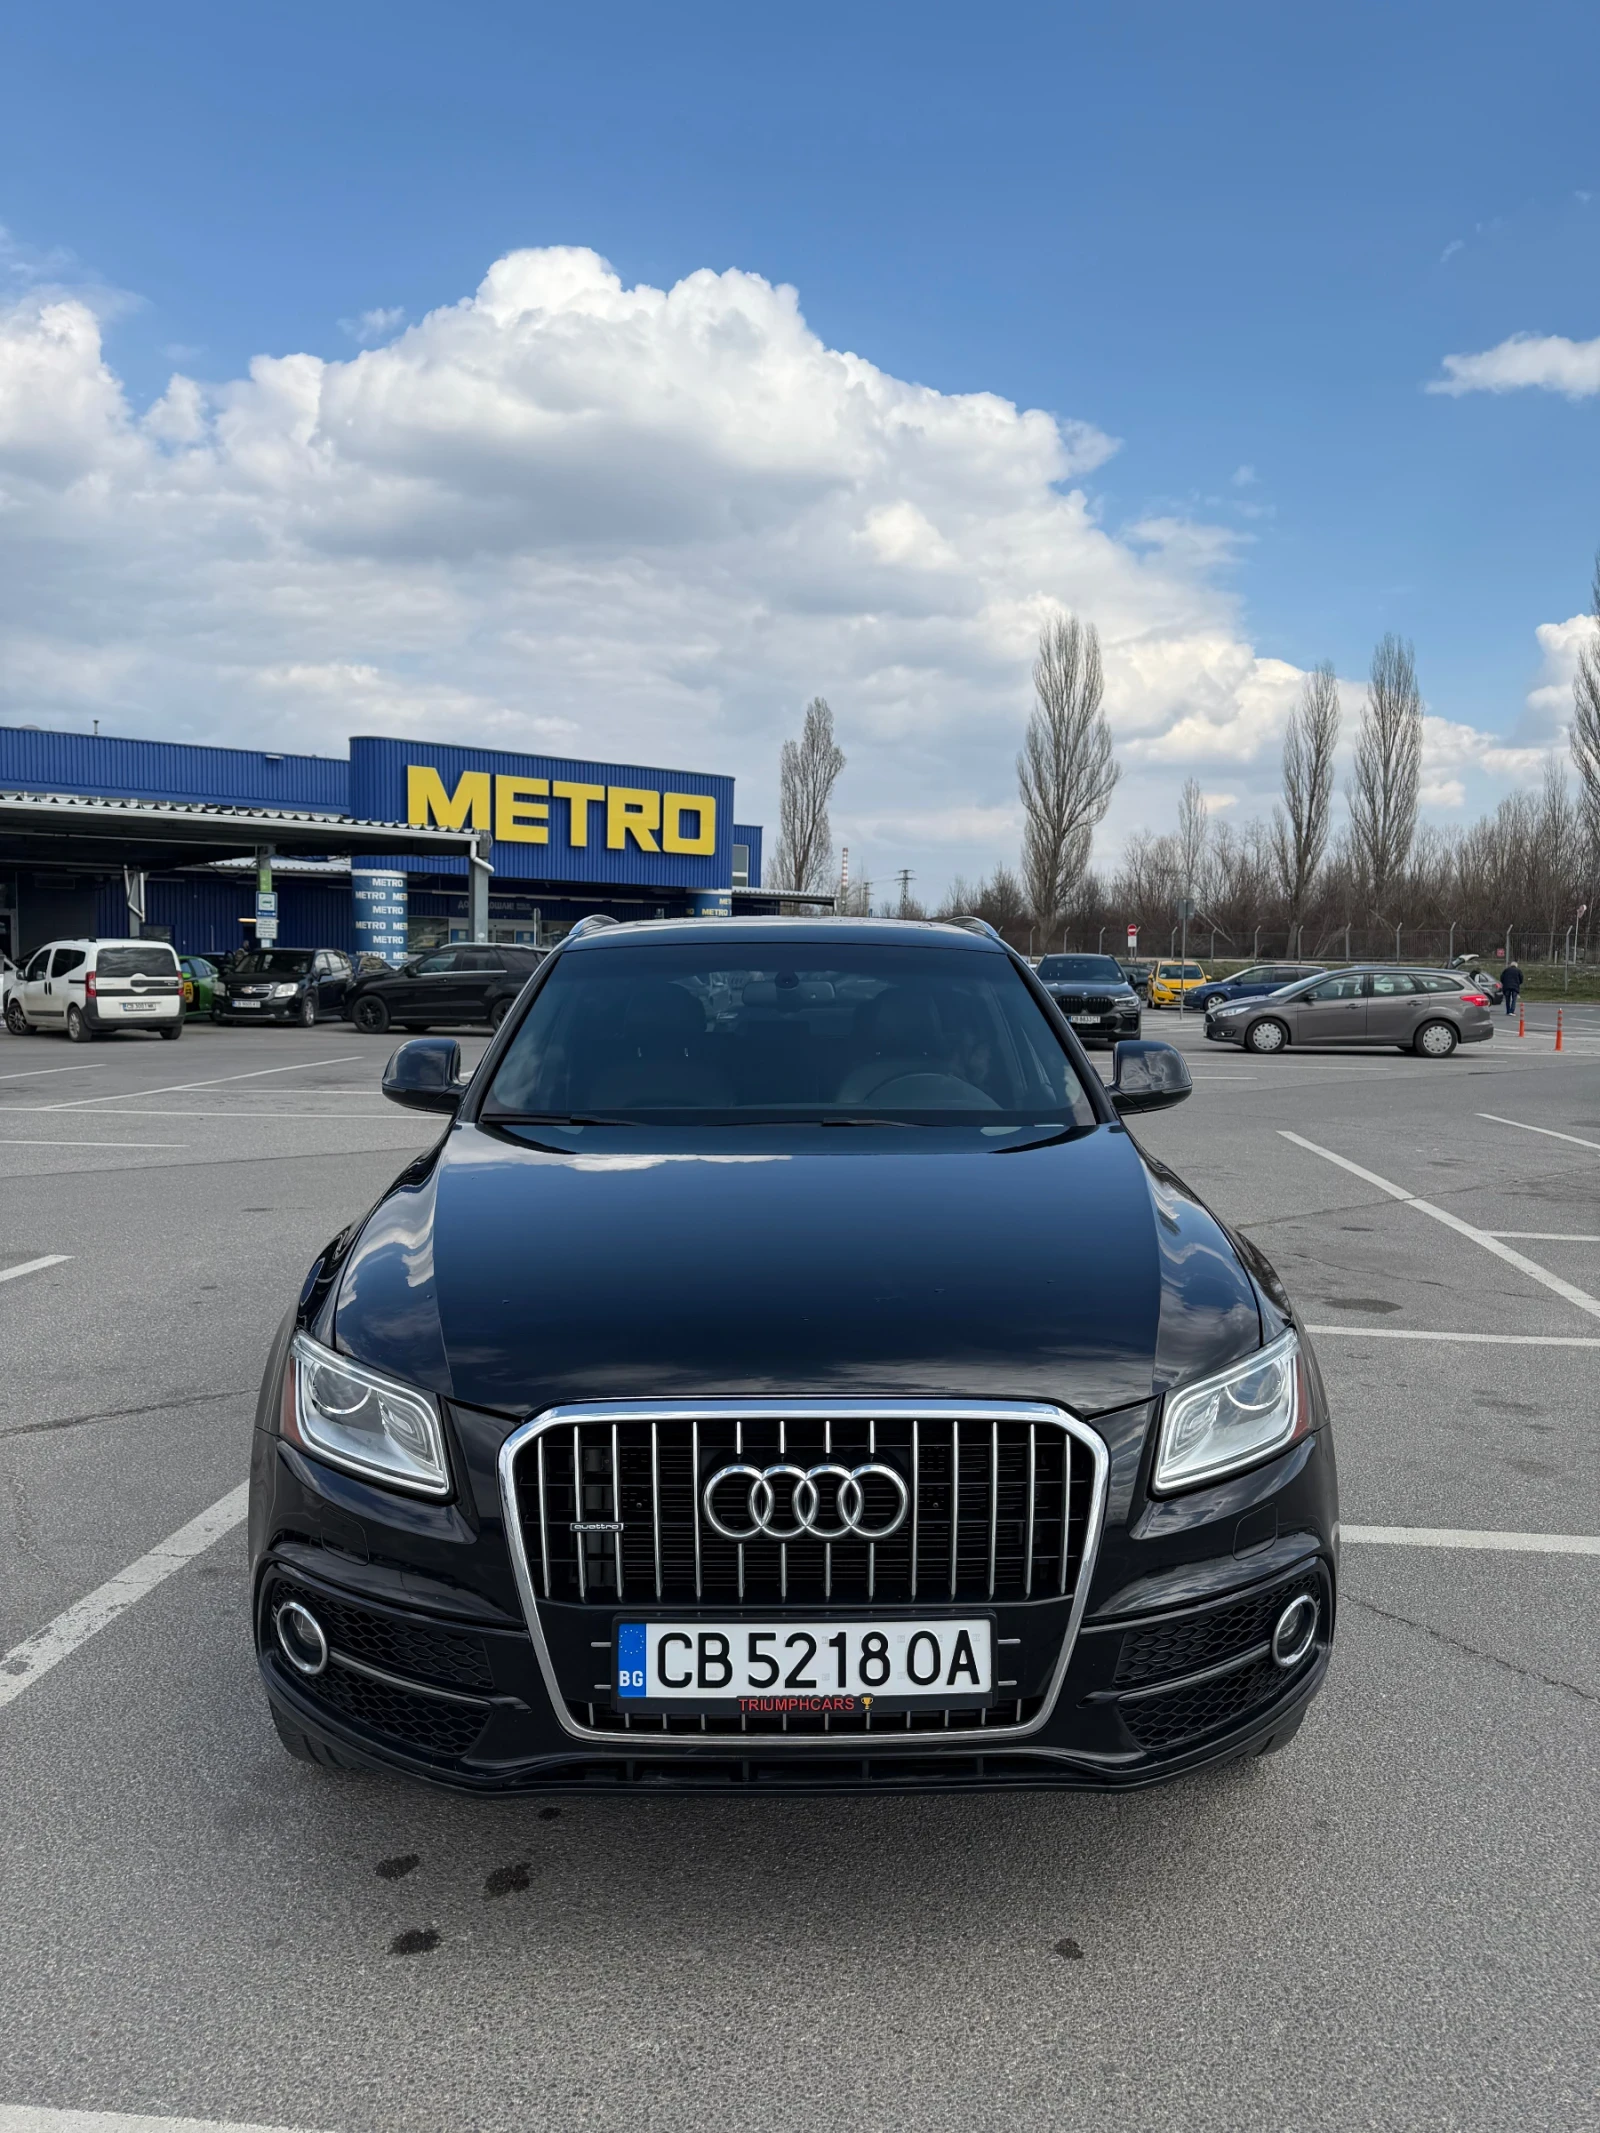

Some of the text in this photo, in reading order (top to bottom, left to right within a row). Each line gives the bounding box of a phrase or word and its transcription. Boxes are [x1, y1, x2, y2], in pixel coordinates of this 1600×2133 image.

[407, 765, 716, 856] METRO
[372, 878, 403, 887] METRO
[355, 891, 386, 900] METRO
[372, 905, 404, 915] METRO
[701, 908, 728, 916] METRO
[355, 921, 386, 930] METRO
[372, 935, 404, 944] METRO
[657, 1629, 981, 1688] CB 5218 OA
[619, 1670, 643, 1687] BG
[739, 1698, 855, 1712] TRIUMPHCARS
